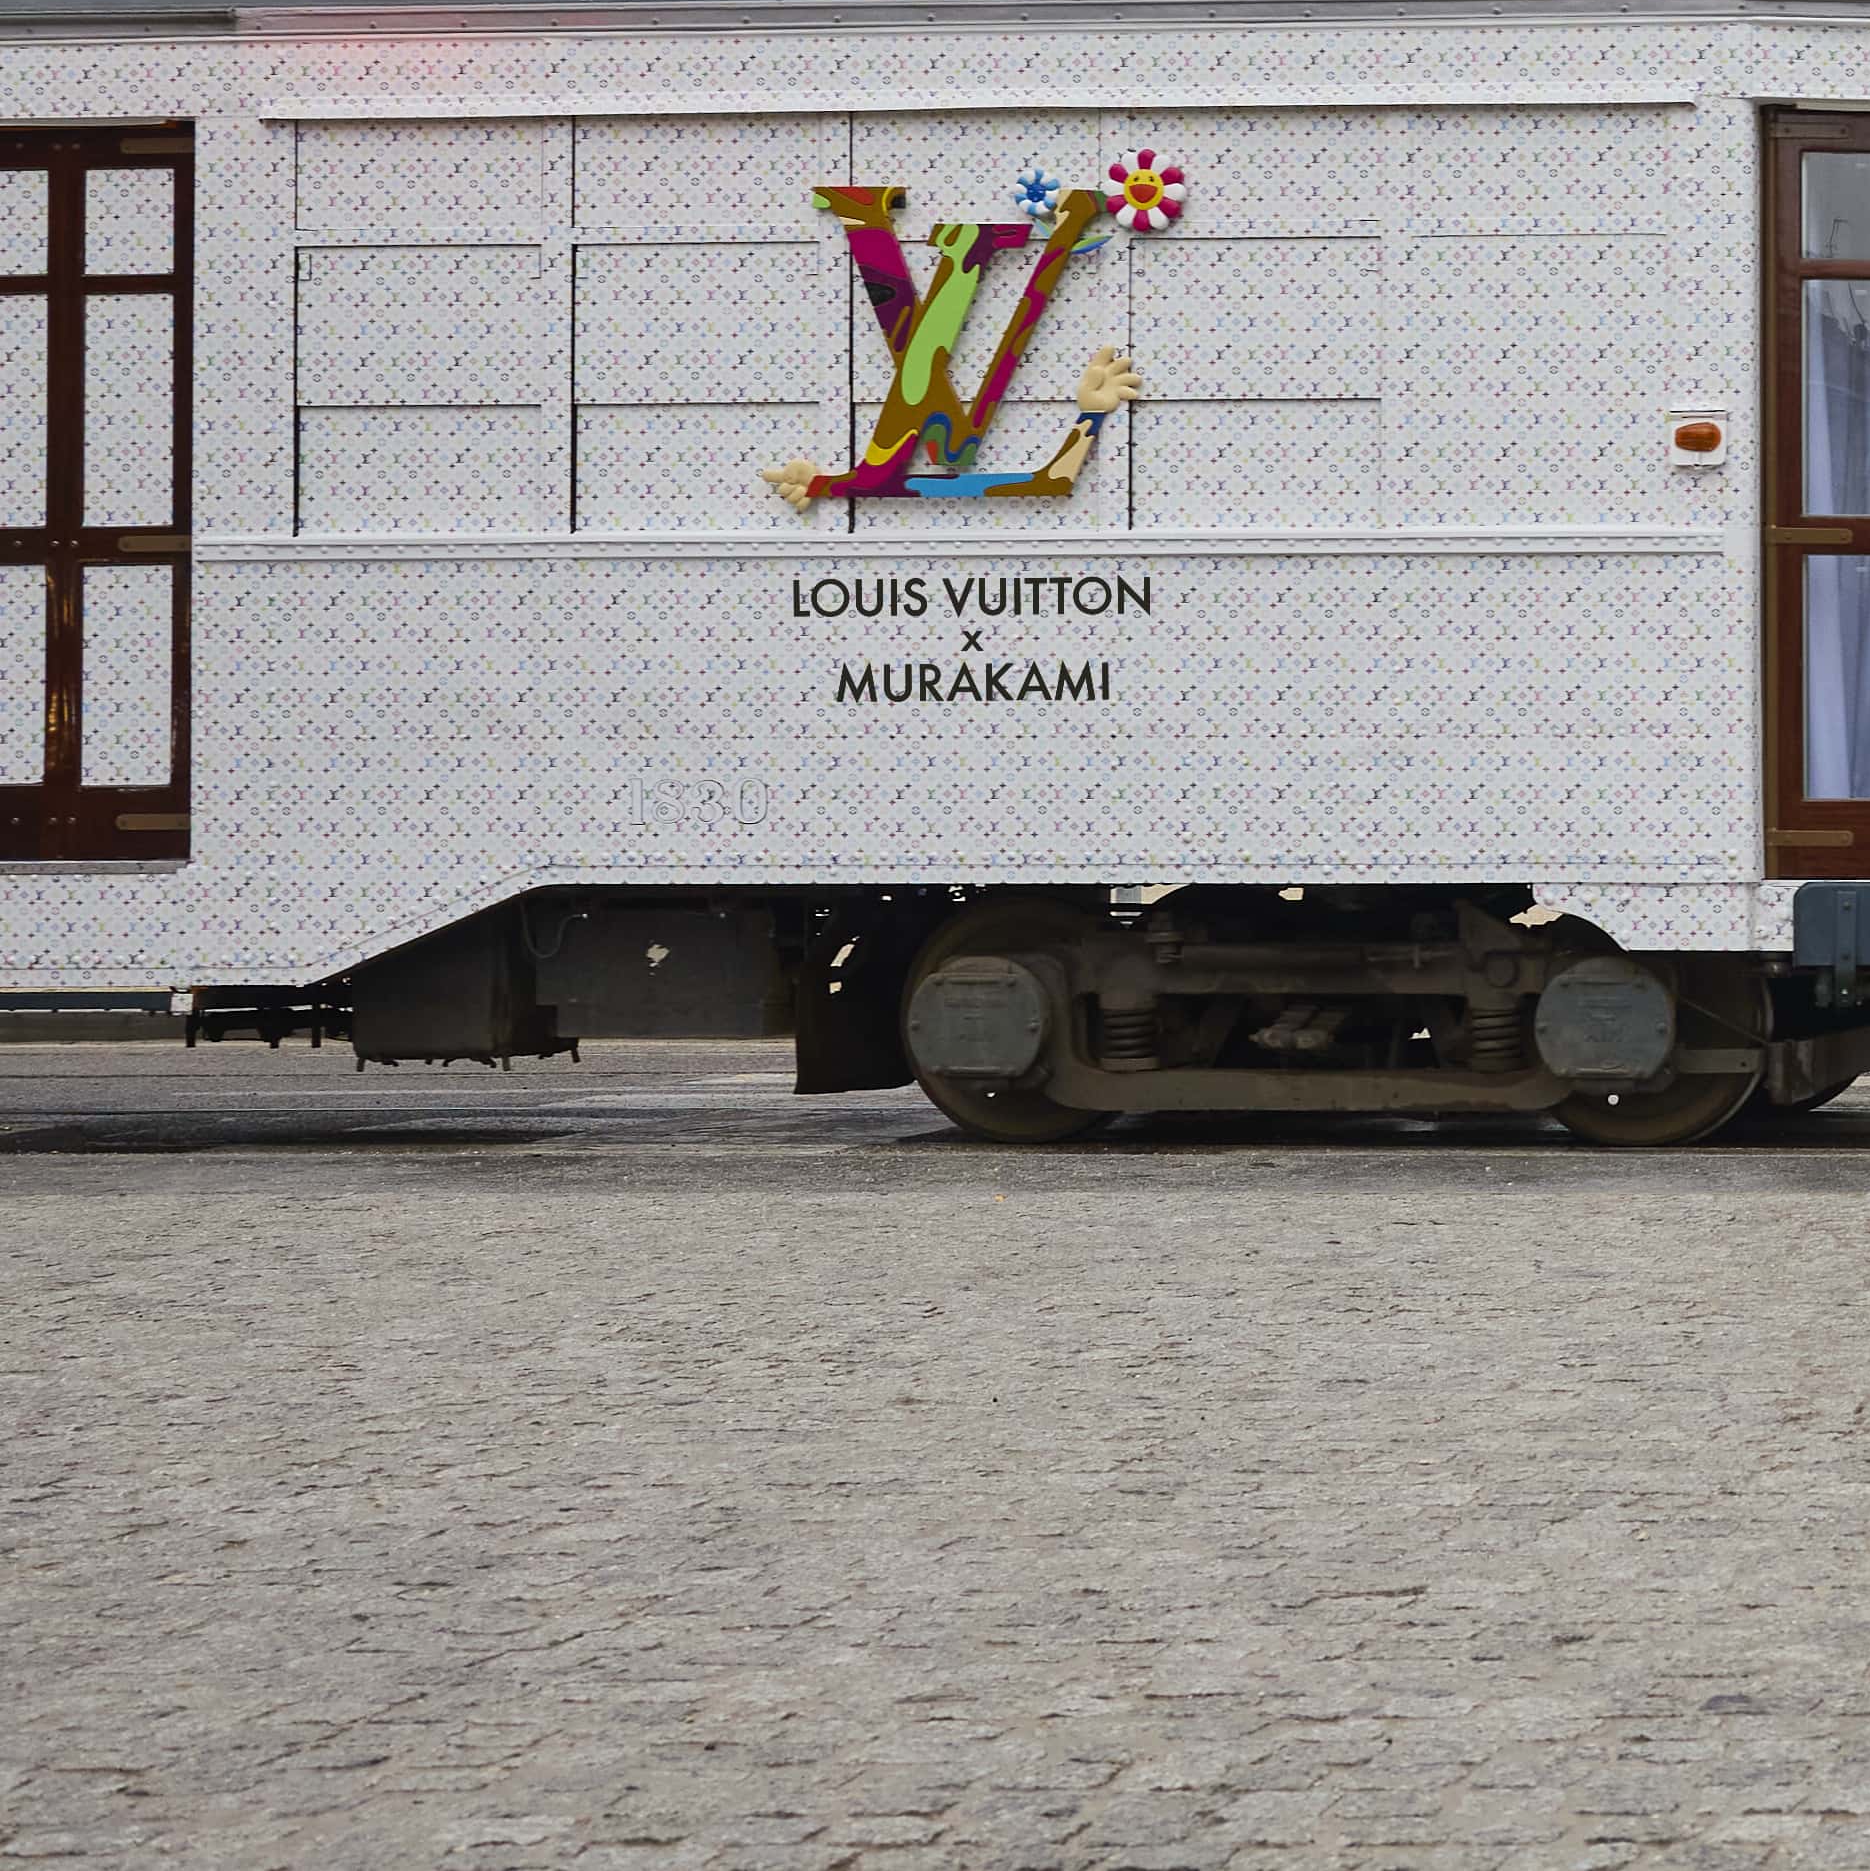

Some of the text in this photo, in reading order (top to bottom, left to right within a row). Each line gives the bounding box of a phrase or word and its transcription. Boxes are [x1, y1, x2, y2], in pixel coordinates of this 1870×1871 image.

[793, 576, 1151, 617] LOUIS VUITTON
[837, 660, 1110, 703] MURAKAMI
[628, 777, 768, 825] 1830
